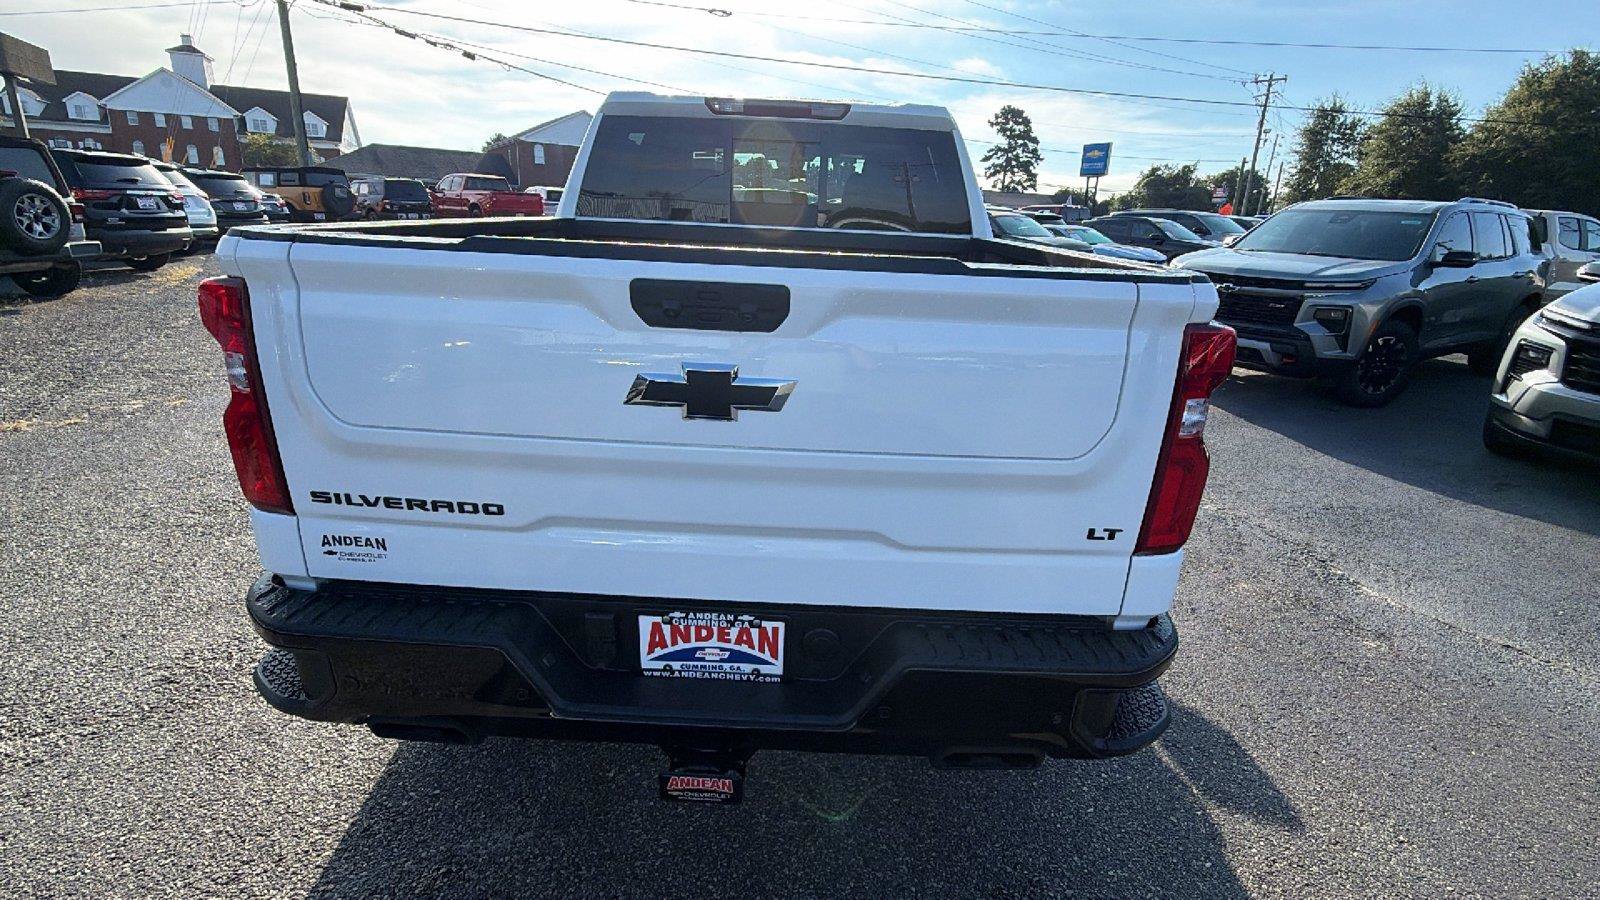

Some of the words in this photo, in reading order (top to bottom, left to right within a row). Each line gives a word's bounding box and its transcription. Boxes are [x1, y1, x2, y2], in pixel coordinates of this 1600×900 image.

[310, 491, 505, 516] SILVERADO
[1087, 528, 1124, 540] LT
[321, 534, 388, 552] ANDEAN
[339, 551, 387, 559] CHEVROLET
[687, 612, 734, 621] ANDEAN
[672, 618, 731, 629] CUMMING,
[735, 621, 751, 629] GA
[647, 621, 779, 660] ANDEAN
[680, 663, 727, 672] CUMMING,
[643, 670, 781, 683] www.ANDEANCHEVY.com
[667, 776, 734, 794] ANDEAN
[684, 791, 731, 799] CHEVROLET
